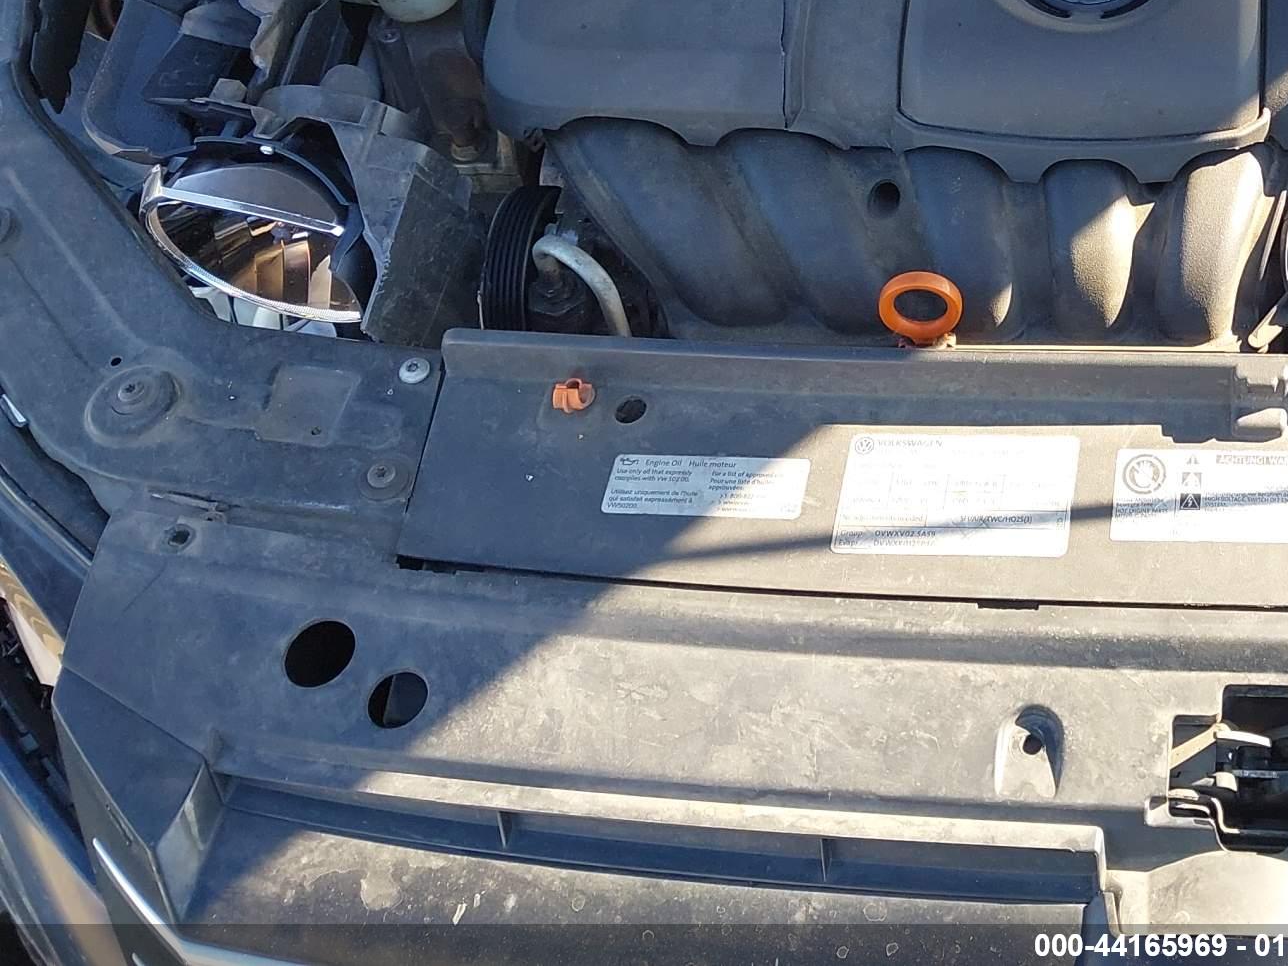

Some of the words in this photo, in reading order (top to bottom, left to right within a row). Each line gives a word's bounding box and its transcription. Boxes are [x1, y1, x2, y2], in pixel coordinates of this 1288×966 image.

[646, 459, 670, 468] Engine
[672, 459, 682, 467] Oil
[688, 460, 709, 468] Huile
